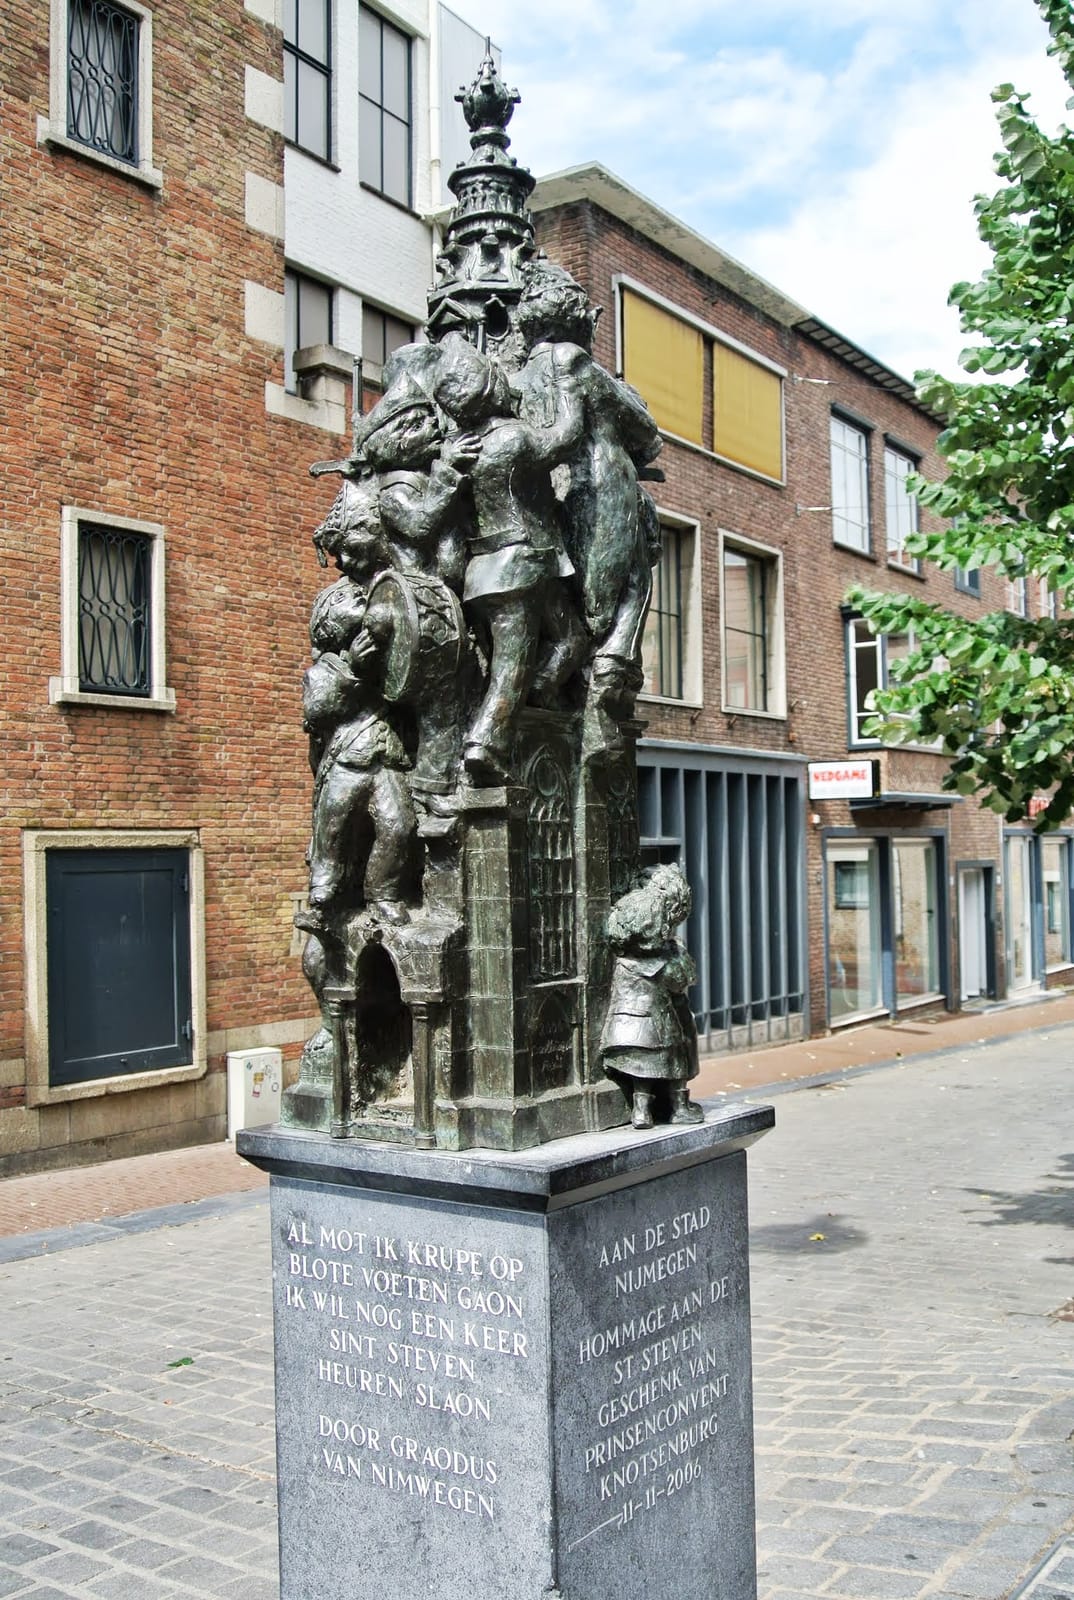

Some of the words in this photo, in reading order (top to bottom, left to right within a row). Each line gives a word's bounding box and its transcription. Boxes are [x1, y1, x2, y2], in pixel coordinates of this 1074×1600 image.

[288, 1222, 313, 1244] AL
[320, 1226, 366, 1254] MOT
[376, 1236, 398, 1260] IK
[408, 1240, 482, 1276] KRUPE
[490, 1255, 523, 1282] OP
[599, 1234, 635, 1268] AAN
[645, 1225, 665, 1251] DE
[672, 1206, 710, 1240] STAD
[290, 1253, 353, 1286] BLOTE
[362, 1267, 448, 1304] VOETEN
[458, 1287, 523, 1318] GAON
[615, 1244, 697, 1298] NIJMEGEN
[286, 1285, 306, 1309] IK
[313, 1291, 348, 1319] WIL
[356, 1301, 401, 1330] NOG
[412, 1312, 454, 1340] EEN
[464, 1323, 527, 1357] KEER
[579, 1306, 666, 1364] HOMMAGE
[671, 1288, 702, 1322] AAN
[711, 1276, 729, 1303] DE
[330, 1329, 376, 1359] SINT
[388, 1342, 475, 1381] STEVEN
[613, 1356, 635, 1385] ST
[642, 1324, 702, 1374] STEVEN
[319, 1359, 403, 1399] HEUREN
[416, 1384, 491, 1420] SLAON
[599, 1366, 681, 1427] GESCHENK
[689, 1349, 716, 1379] VAN
[319, 1415, 380, 1450] DOOR
[391, 1435, 497, 1484] GRAODUS
[584, 1373, 730, 1473] PRINSENCONVENT
[322, 1449, 361, 1479] VAN
[372, 1463, 494, 1518] NIMWEGEN
[601, 1413, 718, 1501] KNOTSENBURG
[621, 1459, 701, 1524] 11-11-2006
